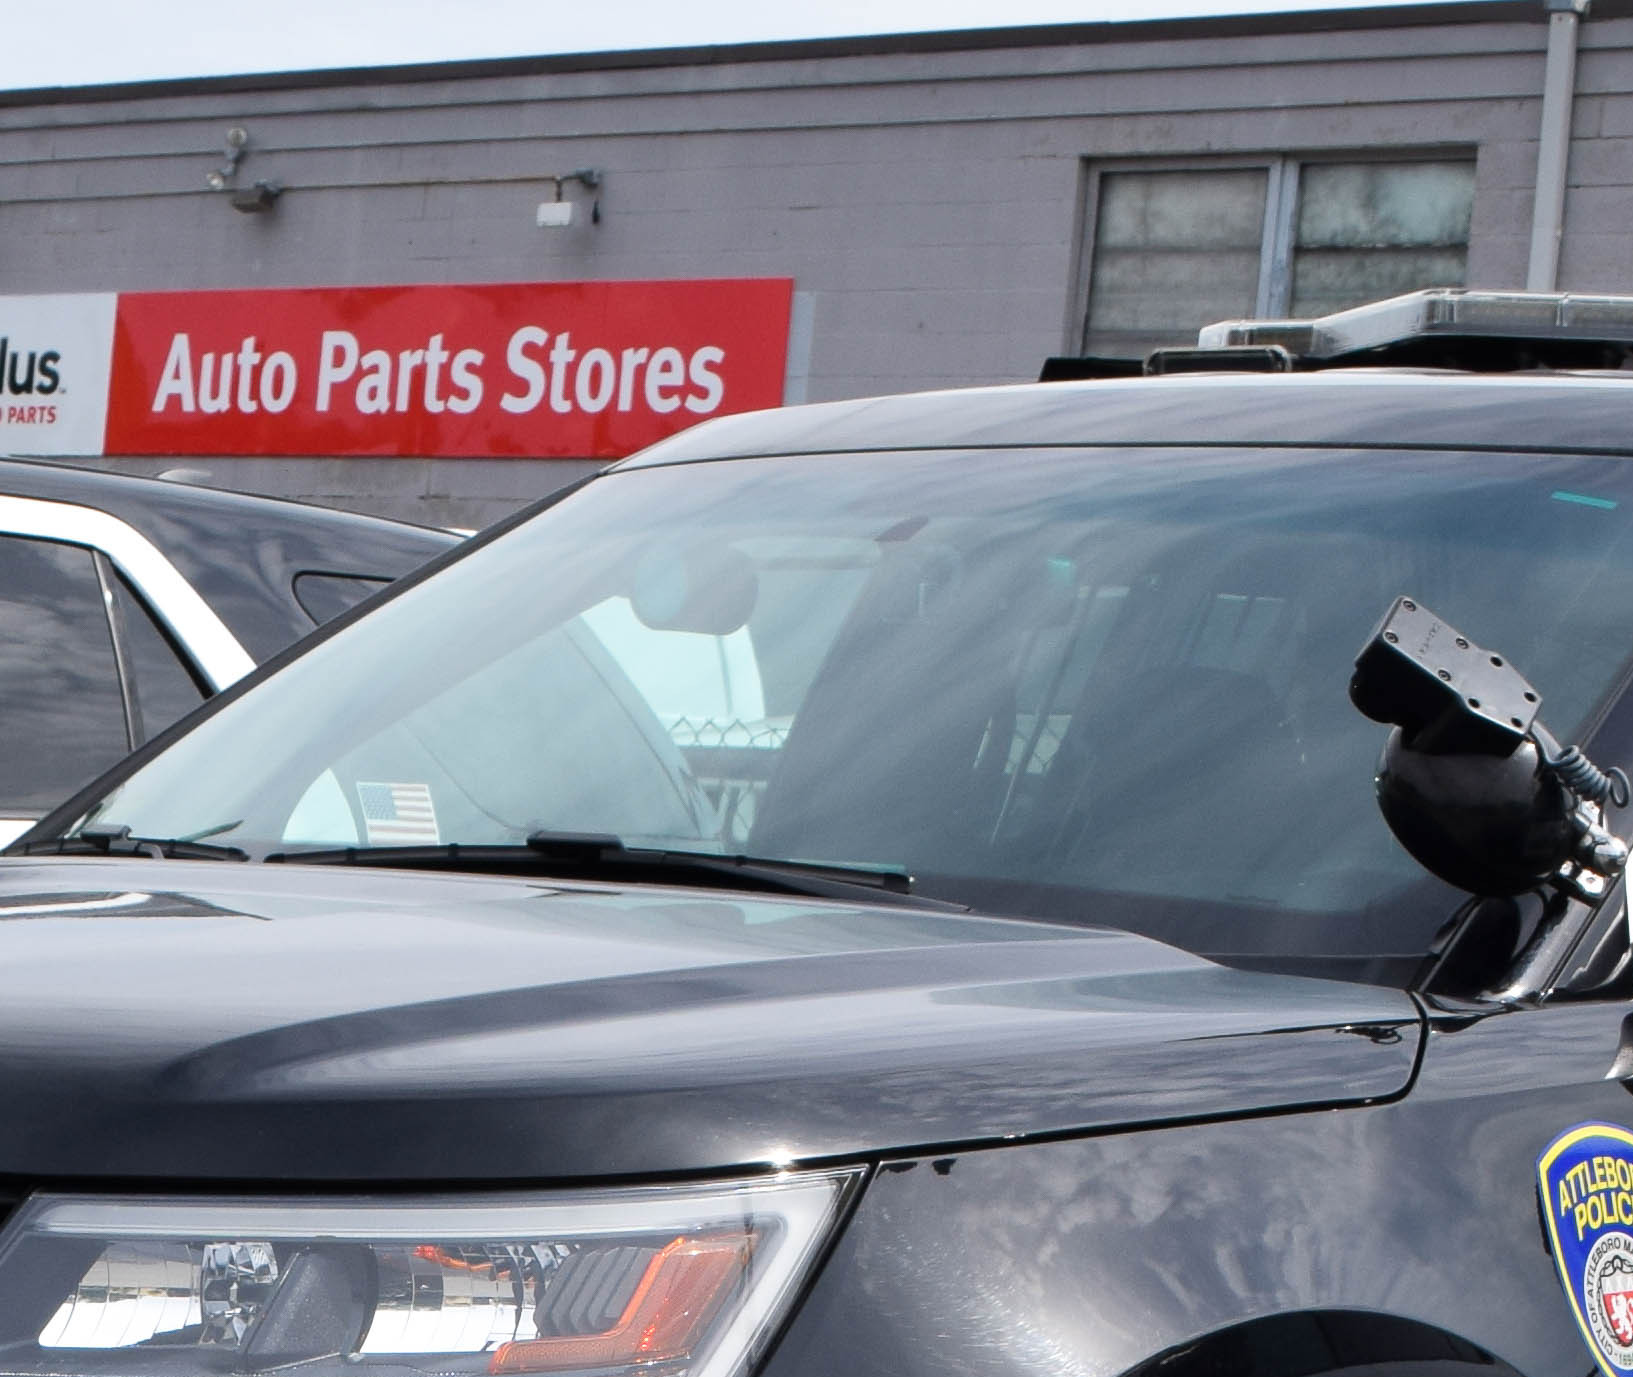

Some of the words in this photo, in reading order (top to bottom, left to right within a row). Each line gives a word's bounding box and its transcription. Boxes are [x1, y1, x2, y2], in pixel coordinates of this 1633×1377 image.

[152, 333, 295, 414] Auto
[316, 329, 484, 414] Parts
[500, 325, 725, 414] Stores
[7, 406, 57, 424] PARTS
[1587, 1237, 1621, 1296] ATTLEBORO
